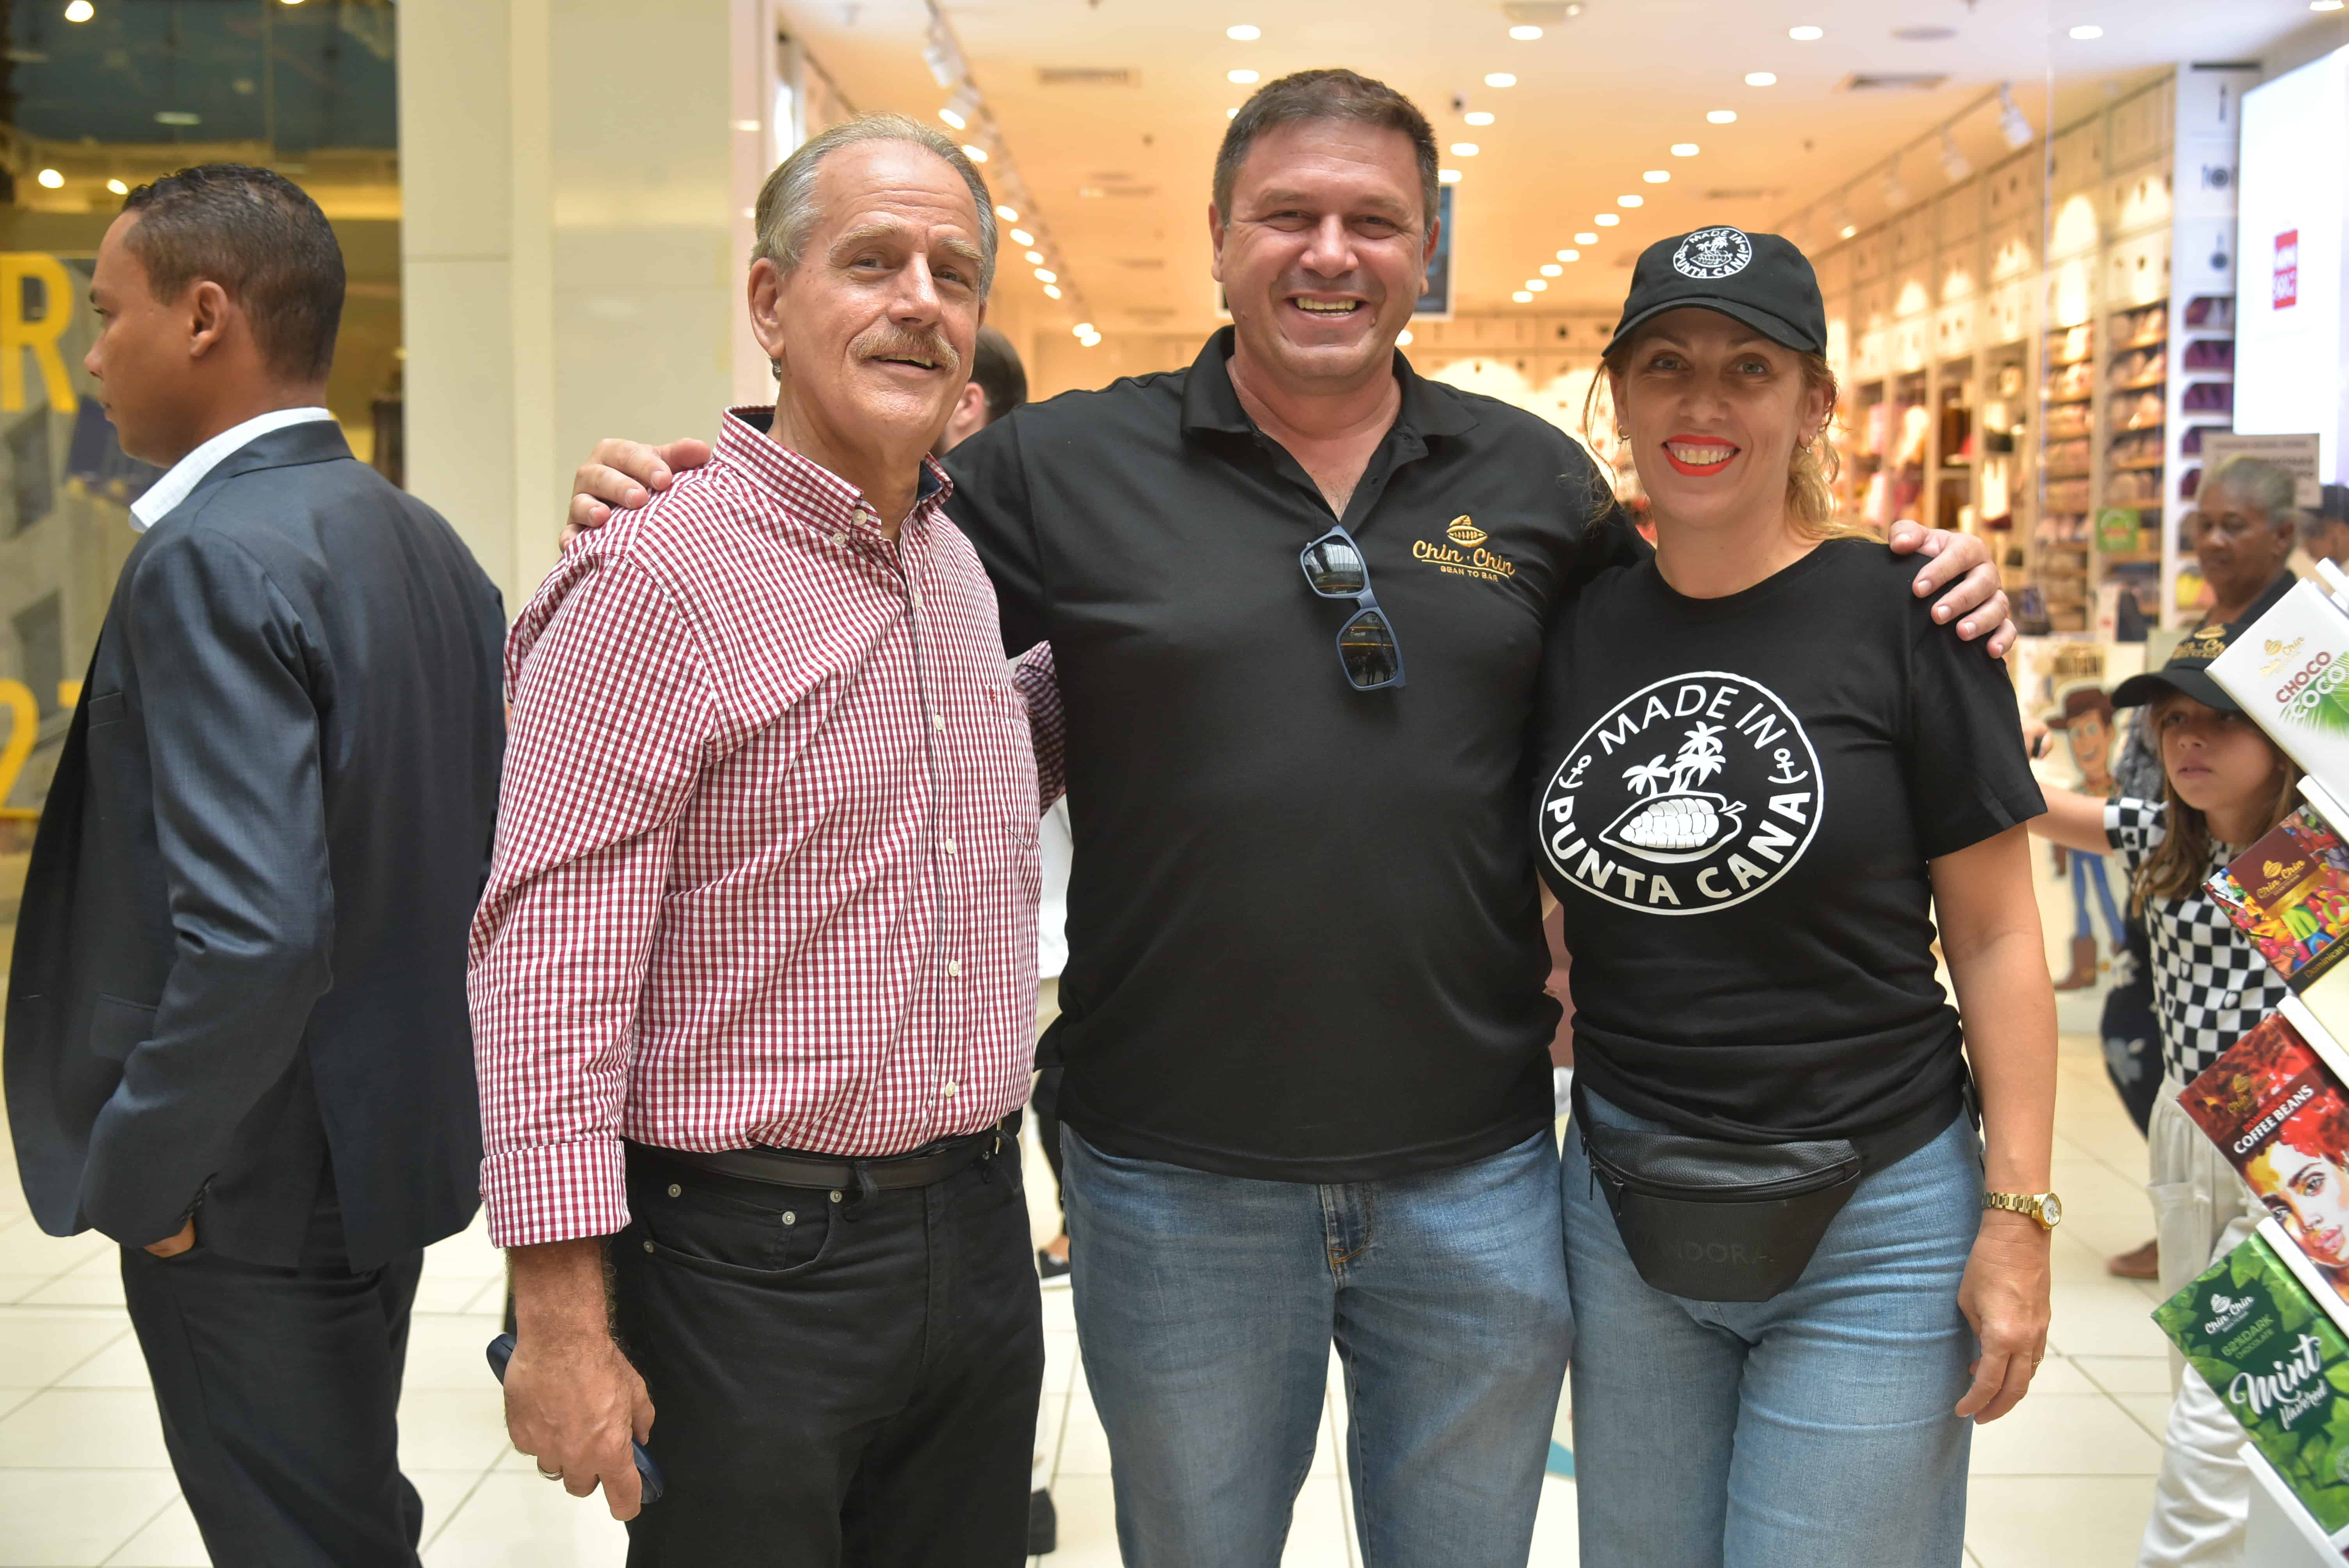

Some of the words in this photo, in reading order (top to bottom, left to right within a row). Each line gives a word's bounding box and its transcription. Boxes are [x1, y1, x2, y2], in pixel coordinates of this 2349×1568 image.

[1689, 230, 1729, 244] MADE
[1730, 233, 1745, 244] IN
[1676, 251, 1707, 277] PUNTA
[1713, 254, 1748, 276] CANA
[1413, 540, 1464, 563] Chin
[1473, 548, 1515, 576] Chin
[1440, 565, 1464, 576] BEAN
[1468, 570, 1480, 578] TO
[1481, 572, 1498, 582] BAR
[2276, 652, 2331, 703] CHOCO
[2291, 666, 2346, 718] COCO
[1597, 685, 1739, 755] MADE
[1735, 702, 1787, 750] IN
[1548, 795, 1681, 905] PUNTA
[1696, 792, 1811, 898] CANA
[2281, 860, 2305, 879] Chin
[2233, 1116, 2277, 1154] COFFEE
[2272, 1084, 2315, 1121] BEANS
[2205, 1315, 2228, 1335] Chin
[2230, 1296, 2255, 1316] Chin
[2235, 1329, 2274, 1360] CHOCOLATE
[2229, 1333, 2321, 1415] Mint
